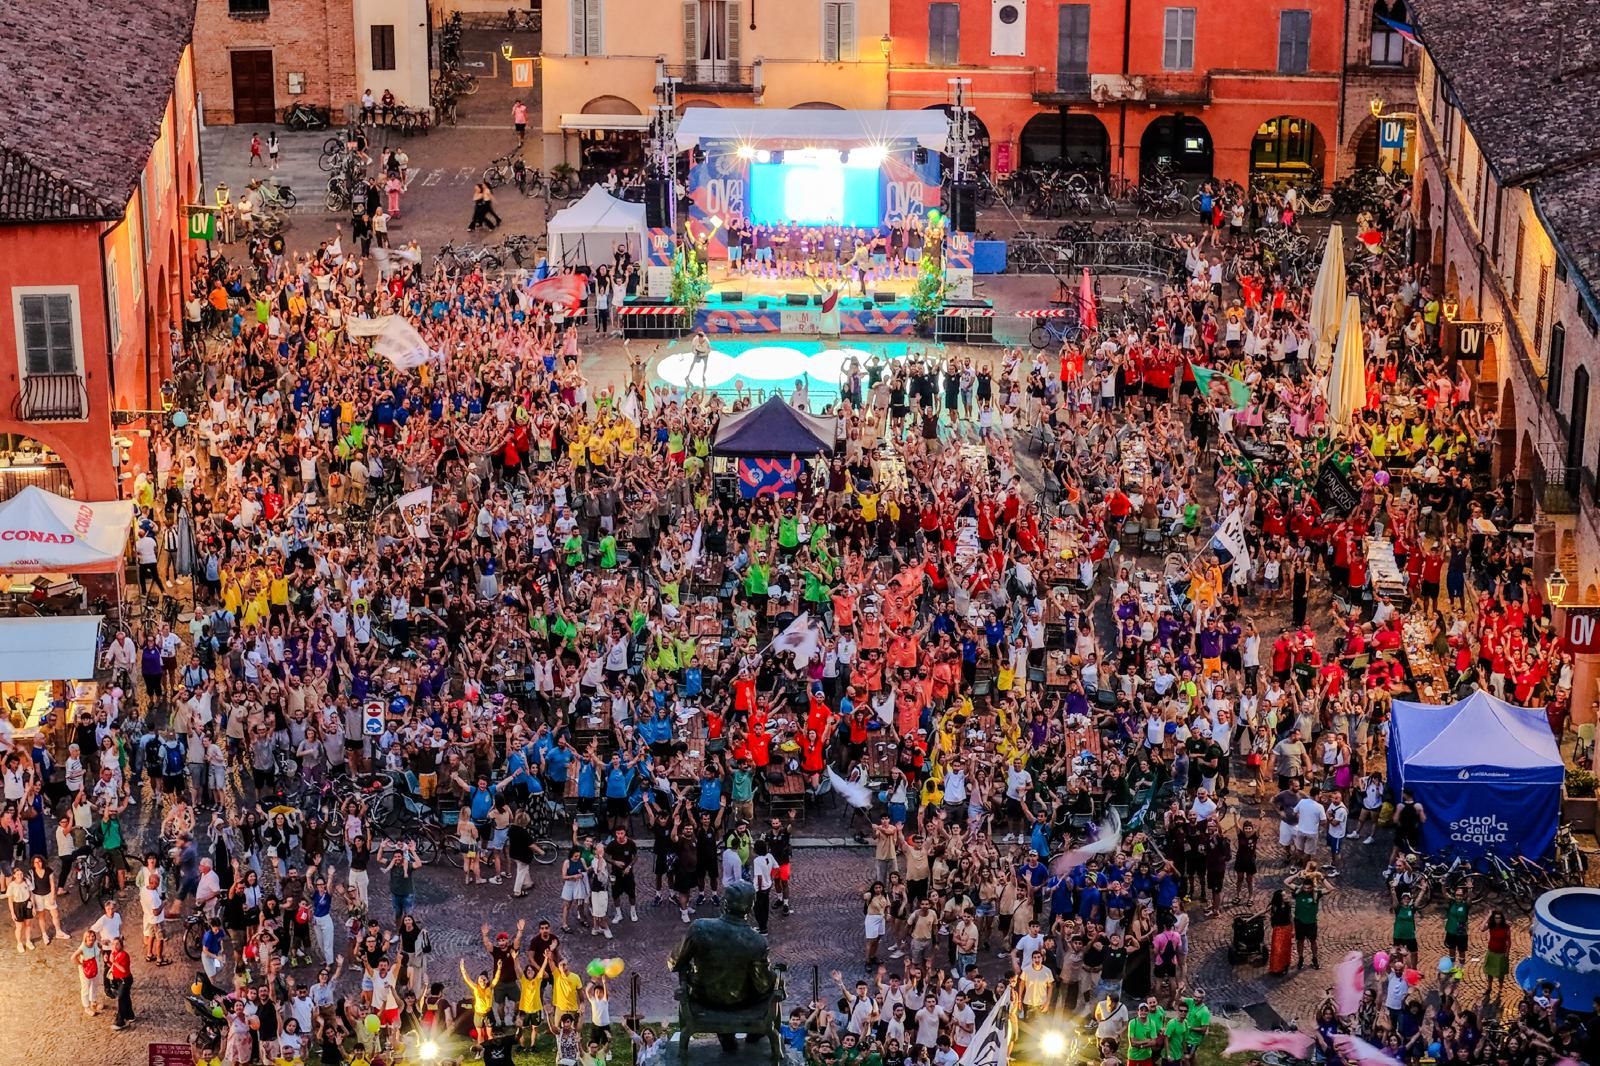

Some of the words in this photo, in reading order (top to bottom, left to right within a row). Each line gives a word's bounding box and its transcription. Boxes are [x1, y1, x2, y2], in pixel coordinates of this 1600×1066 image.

[515, 63, 529, 82] OV
[1385, 121, 1401, 142] OV
[192, 212, 210, 234] OV
[1461, 328, 1480, 354] OV
[74, 504, 93, 534] CONAD
[1, 530, 75, 544] CONAD
[1571, 614, 1596, 646] OV
[1449, 814, 1509, 830] scuola
[1466, 825, 1492, 834] dell'
[1450, 833, 1506, 846] acqua
